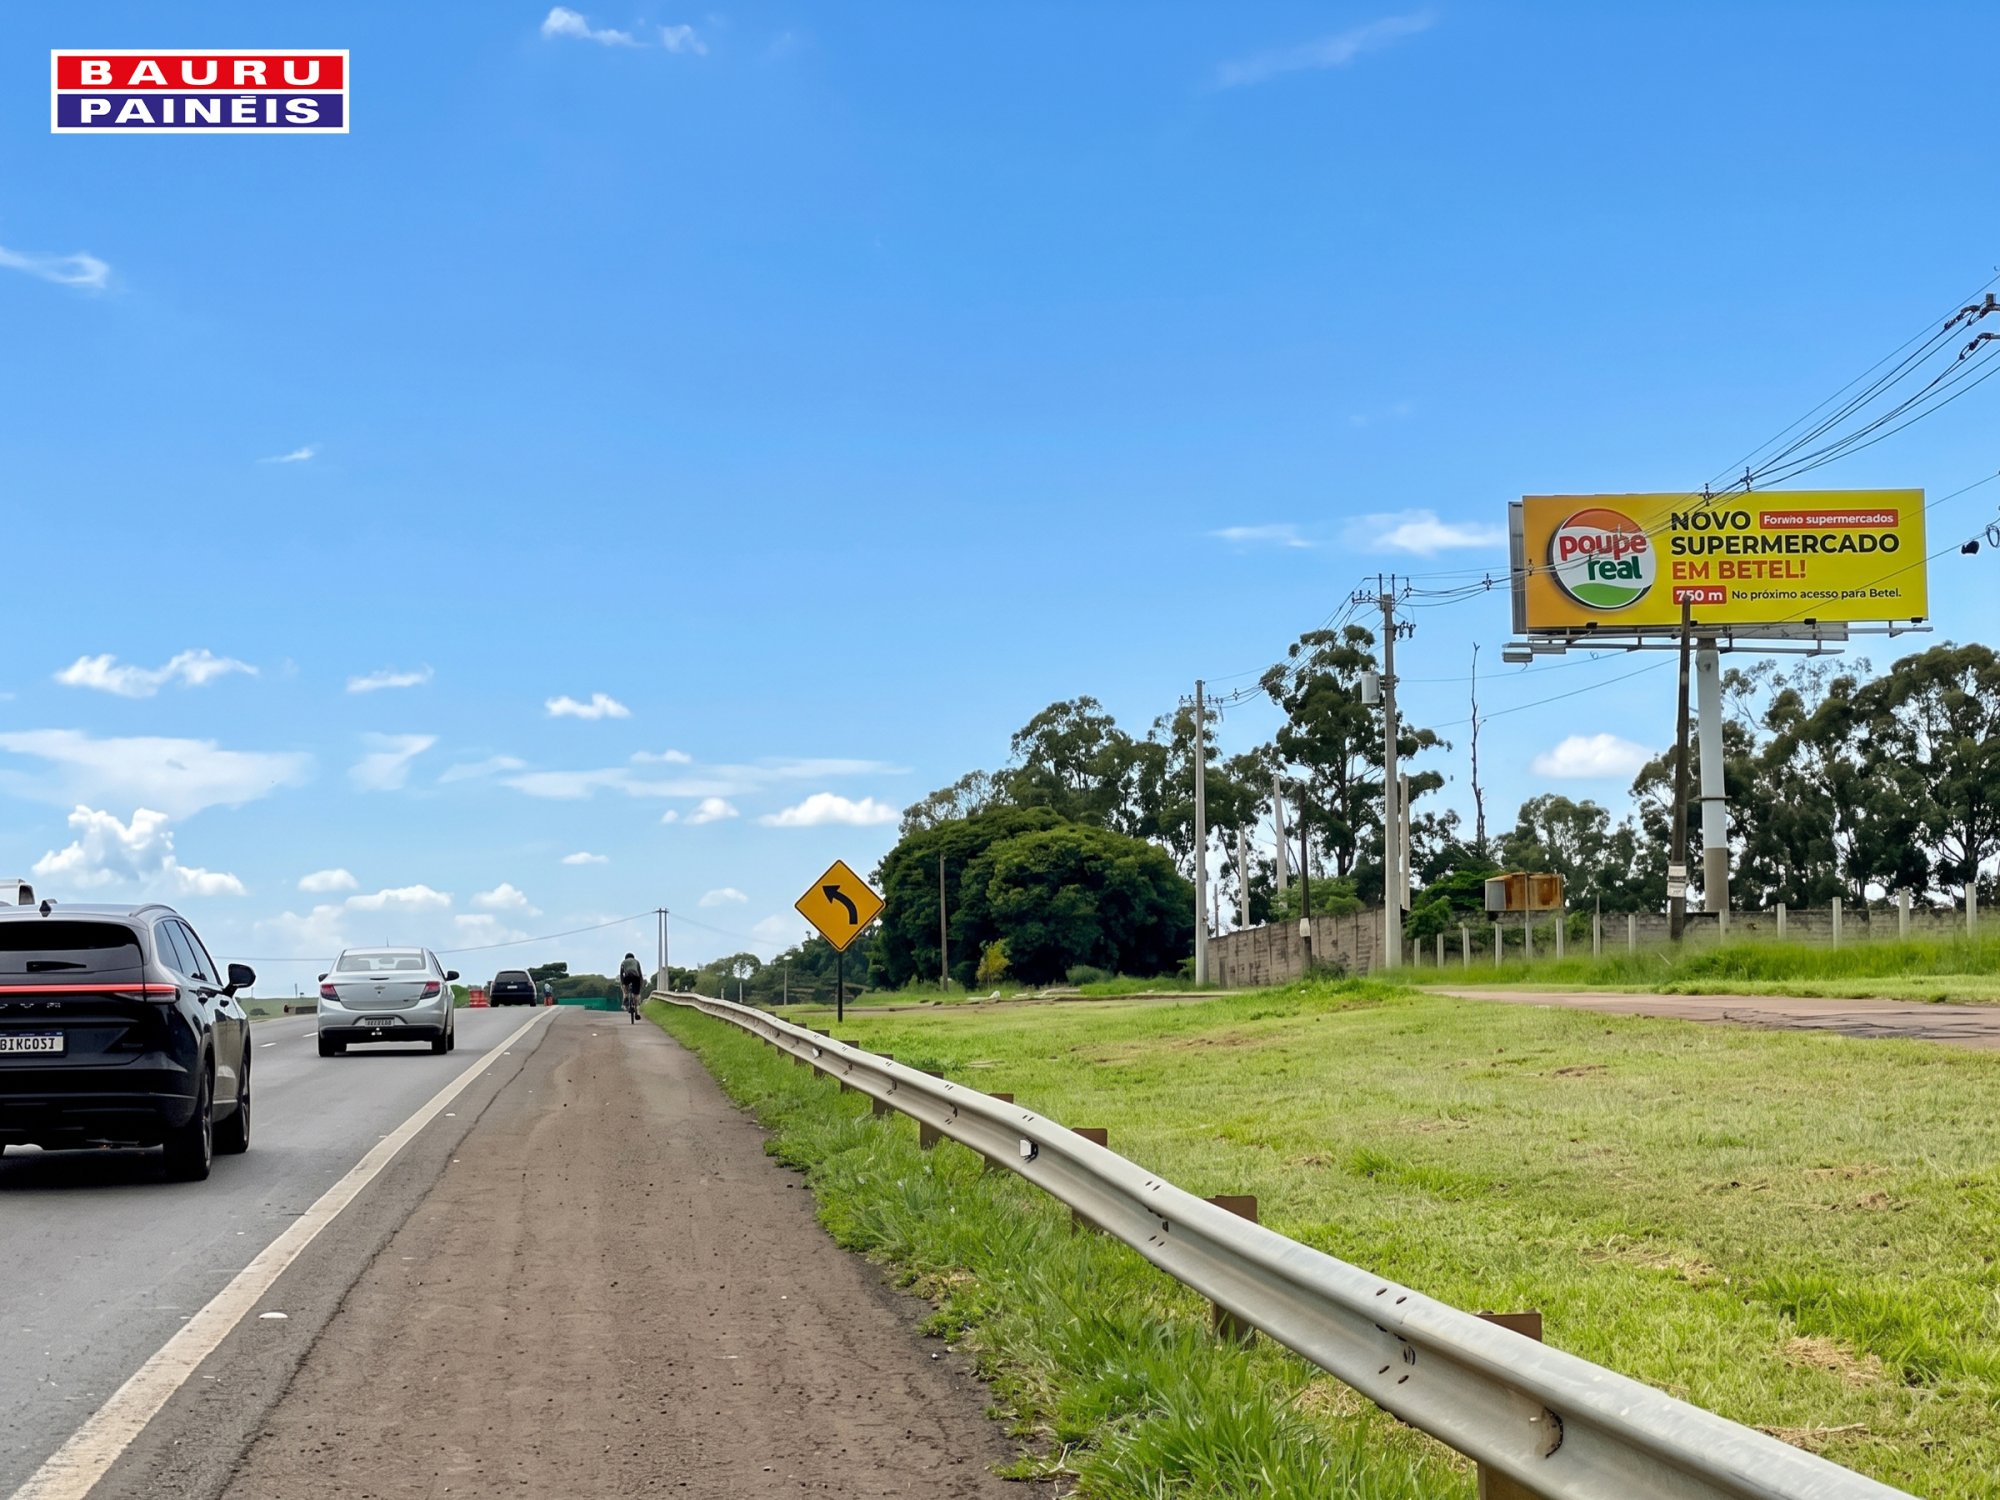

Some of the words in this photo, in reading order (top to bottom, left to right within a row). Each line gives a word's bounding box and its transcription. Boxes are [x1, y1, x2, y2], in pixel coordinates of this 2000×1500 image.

[1671, 511, 1751, 531] NOVO
[1806, 513, 1894, 525] supermercados
[1559, 534, 1647, 561] poupe
[1671, 533, 1900, 555] SUPERMERCADO
[1587, 555, 1643, 581] real
[1672, 561, 1710, 580] EM
[1718, 559, 1806, 579] BETEL!
[1676, 589, 1705, 602] 750
[1708, 591, 1723, 601] m
[1732, 590, 1748, 599] No
[1750, 588, 1798, 601] próximo
[1800, 590, 1840, 599] acesso
[1841, 589, 1866, 600] para
[1869, 588, 1902, 598] Betel.
